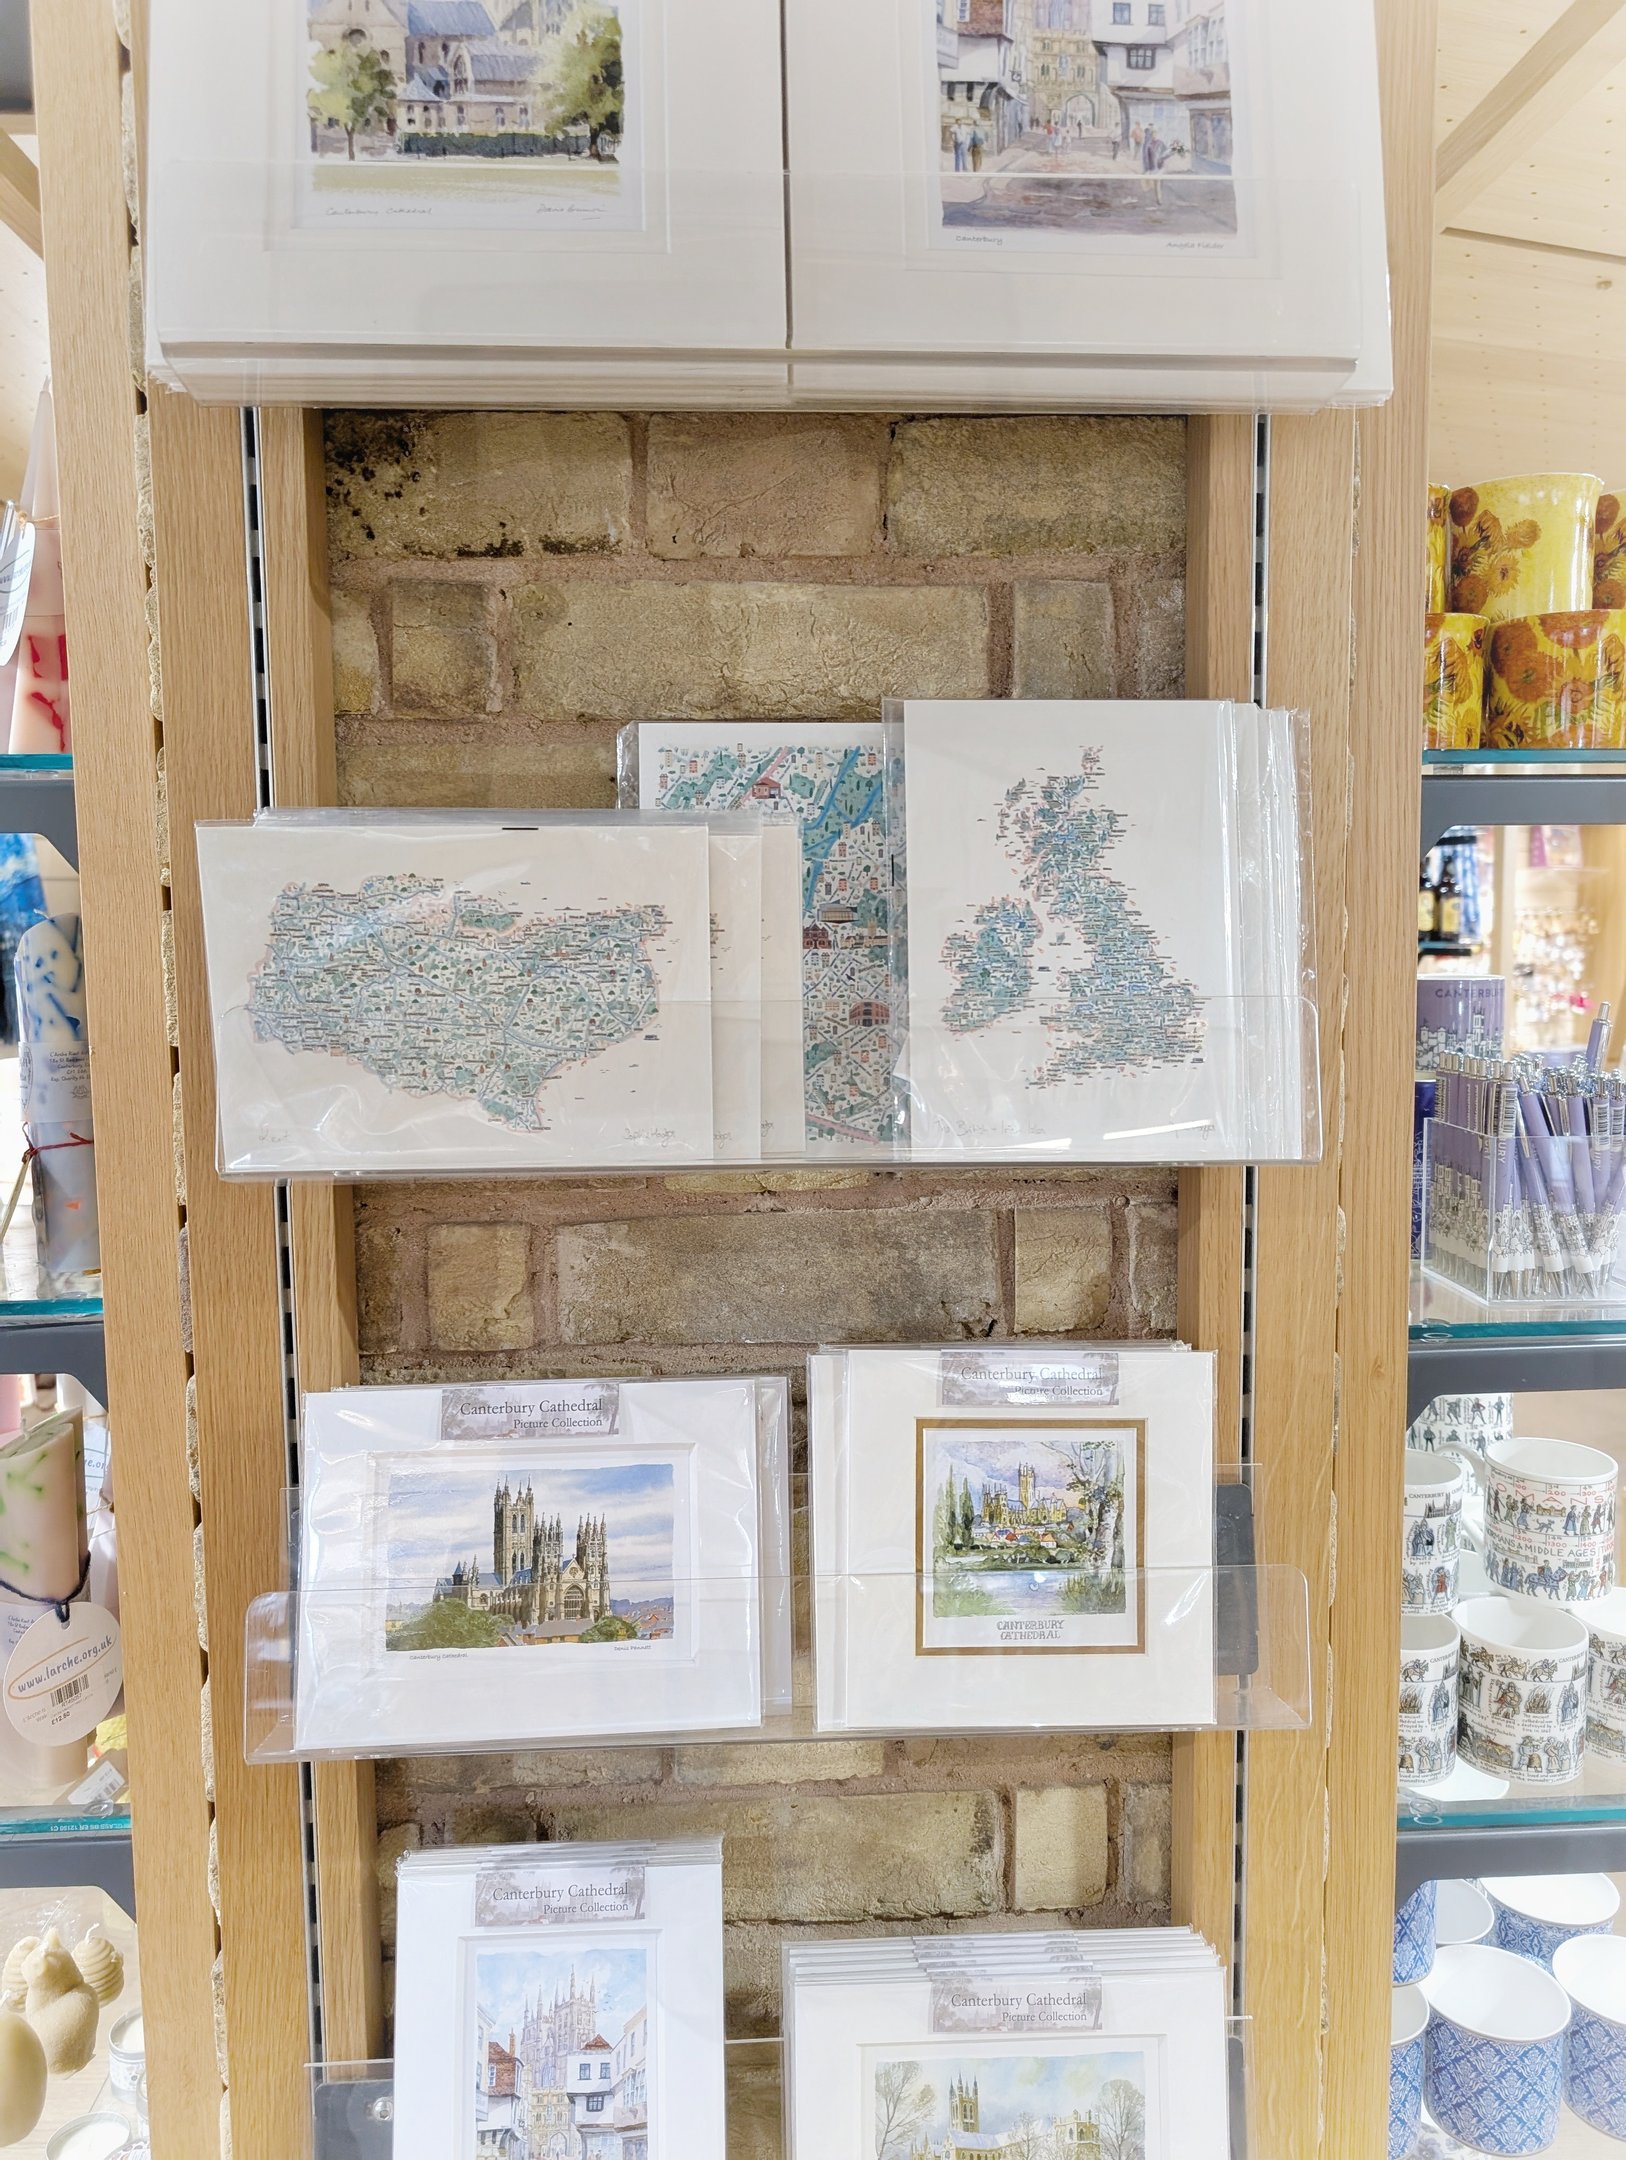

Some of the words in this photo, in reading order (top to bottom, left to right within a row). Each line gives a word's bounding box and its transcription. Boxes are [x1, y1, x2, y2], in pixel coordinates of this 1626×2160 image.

[961, 1367, 1035, 1383] Canterbury
[1039, 1367, 1103, 1380] Cathedral
[1014, 1386, 1050, 1396] Picture
[1052, 1385, 1103, 1396] Collection
[460, 1401, 536, 1417] Canterbury
[539, 1398, 603, 1413] Cathedral
[513, 1419, 549, 1429] Picture
[552, 1417, 603, 1428] Collection
[1547, 1489, 1567, 1497] 200
[1525, 1543, 1564, 1557] MIDDLE
[1567, 1548, 1597, 1558] AGES
[996, 1619, 1066, 1631] CANTERBURY
[1000, 1630, 1061, 1641] CATHEDRAL
[17, 1635, 113, 1693] www.larche.org.uk
[493, 1887, 565, 1902] Canterbury
[568, 1882, 629, 1897] Cathedral
[543, 1904, 577, 1915] Picture
[580, 1902, 629, 1913] Collection
[951, 1993, 1023, 2010] Canterbury
[1026, 1992, 1087, 2006] Cathedral
[1002, 2012, 1036, 2022] Picture
[1038, 2011, 1087, 2021] Collection
